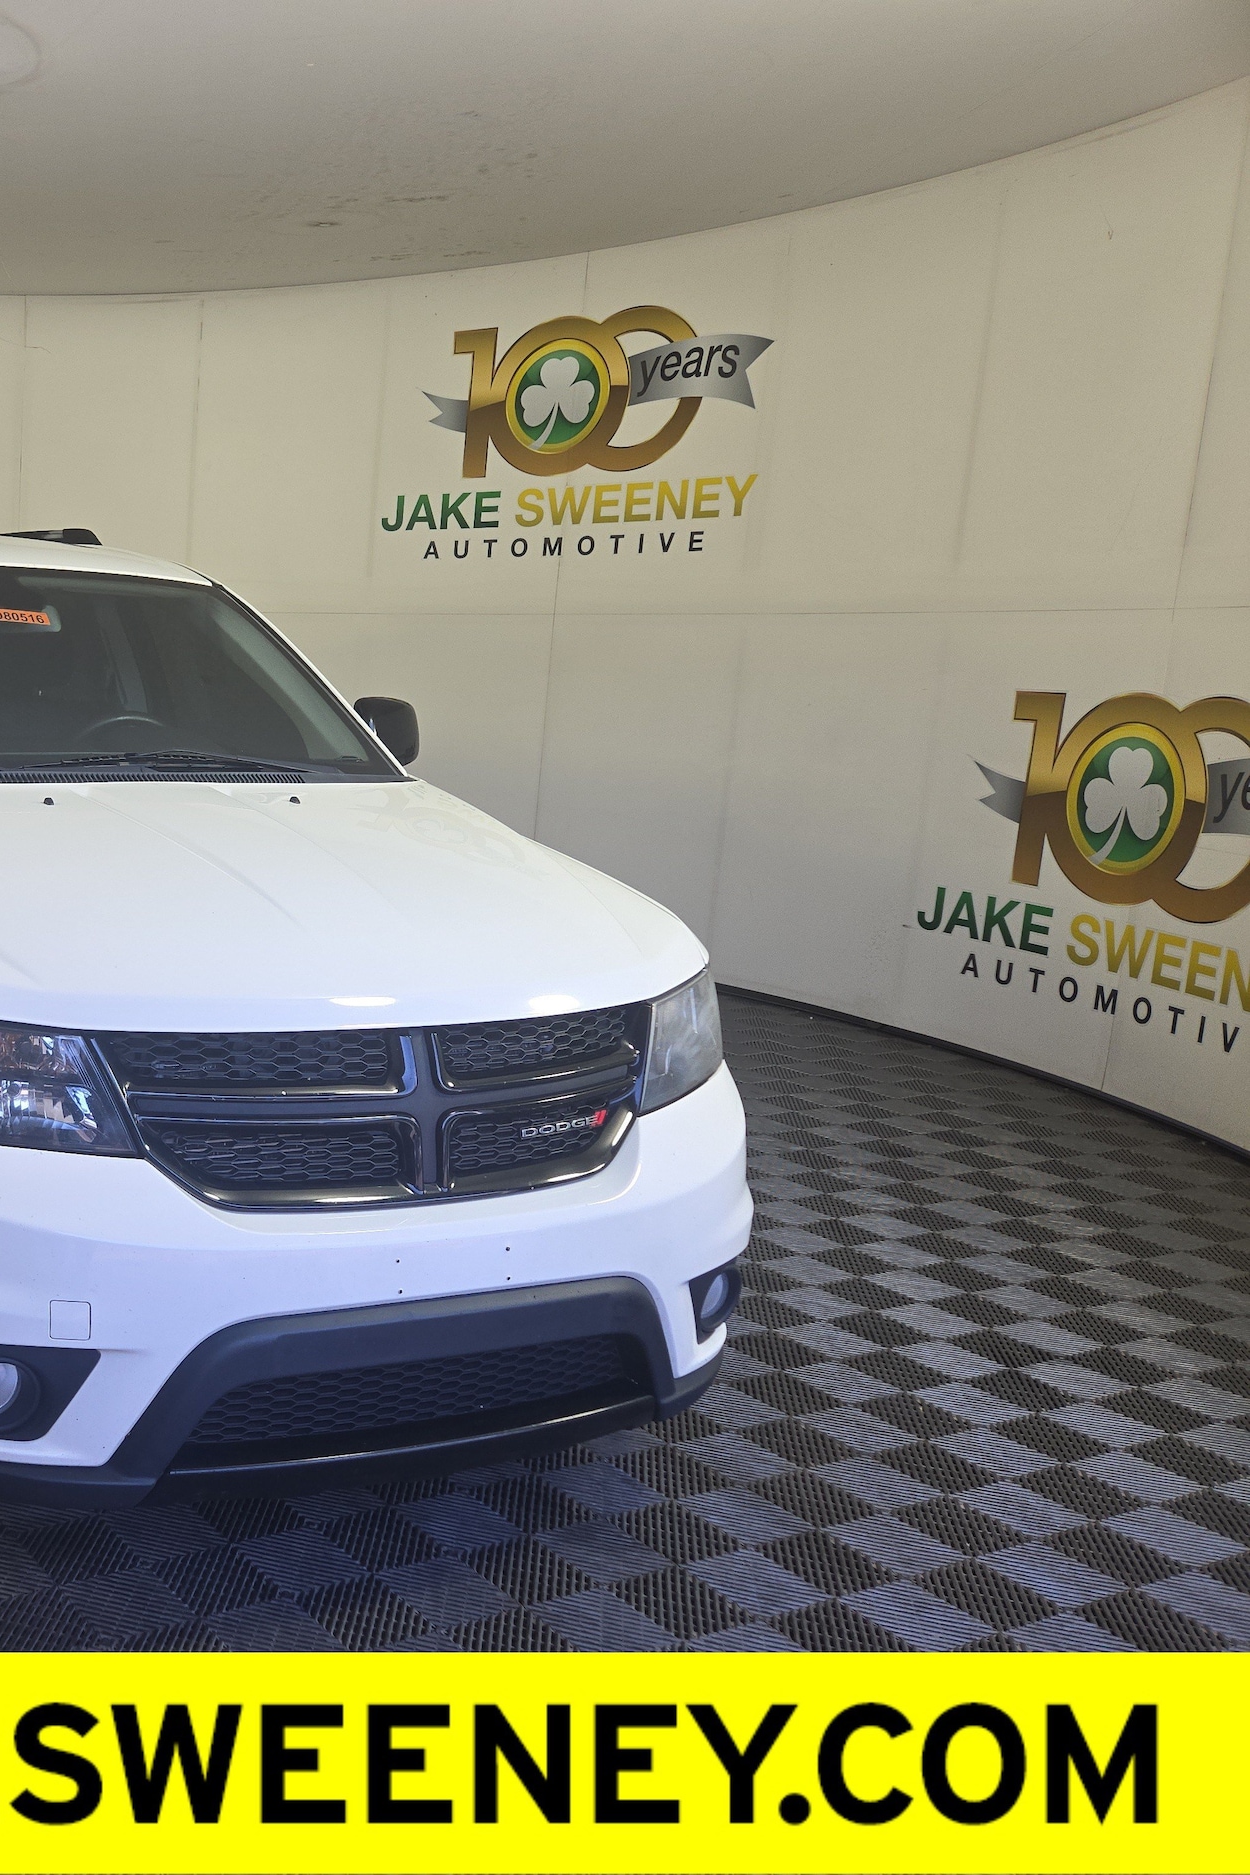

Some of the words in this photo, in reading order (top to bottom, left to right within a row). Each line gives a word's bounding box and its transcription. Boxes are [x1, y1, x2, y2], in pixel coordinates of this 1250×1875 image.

[454, 305, 703, 478] 100
[637, 340, 741, 397] years
[382, 490, 502, 531] JAKE
[515, 474, 759, 527] SWEENEY
[423, 531, 705, 559] AUTOMOTIVE
[917, 886, 1054, 956] JAKE
[1066, 913, 1250, 1014] SWEEN
[960, 953, 1240, 1053] AUTOMOTIV
[521, 1115, 599, 1139] DODGE
